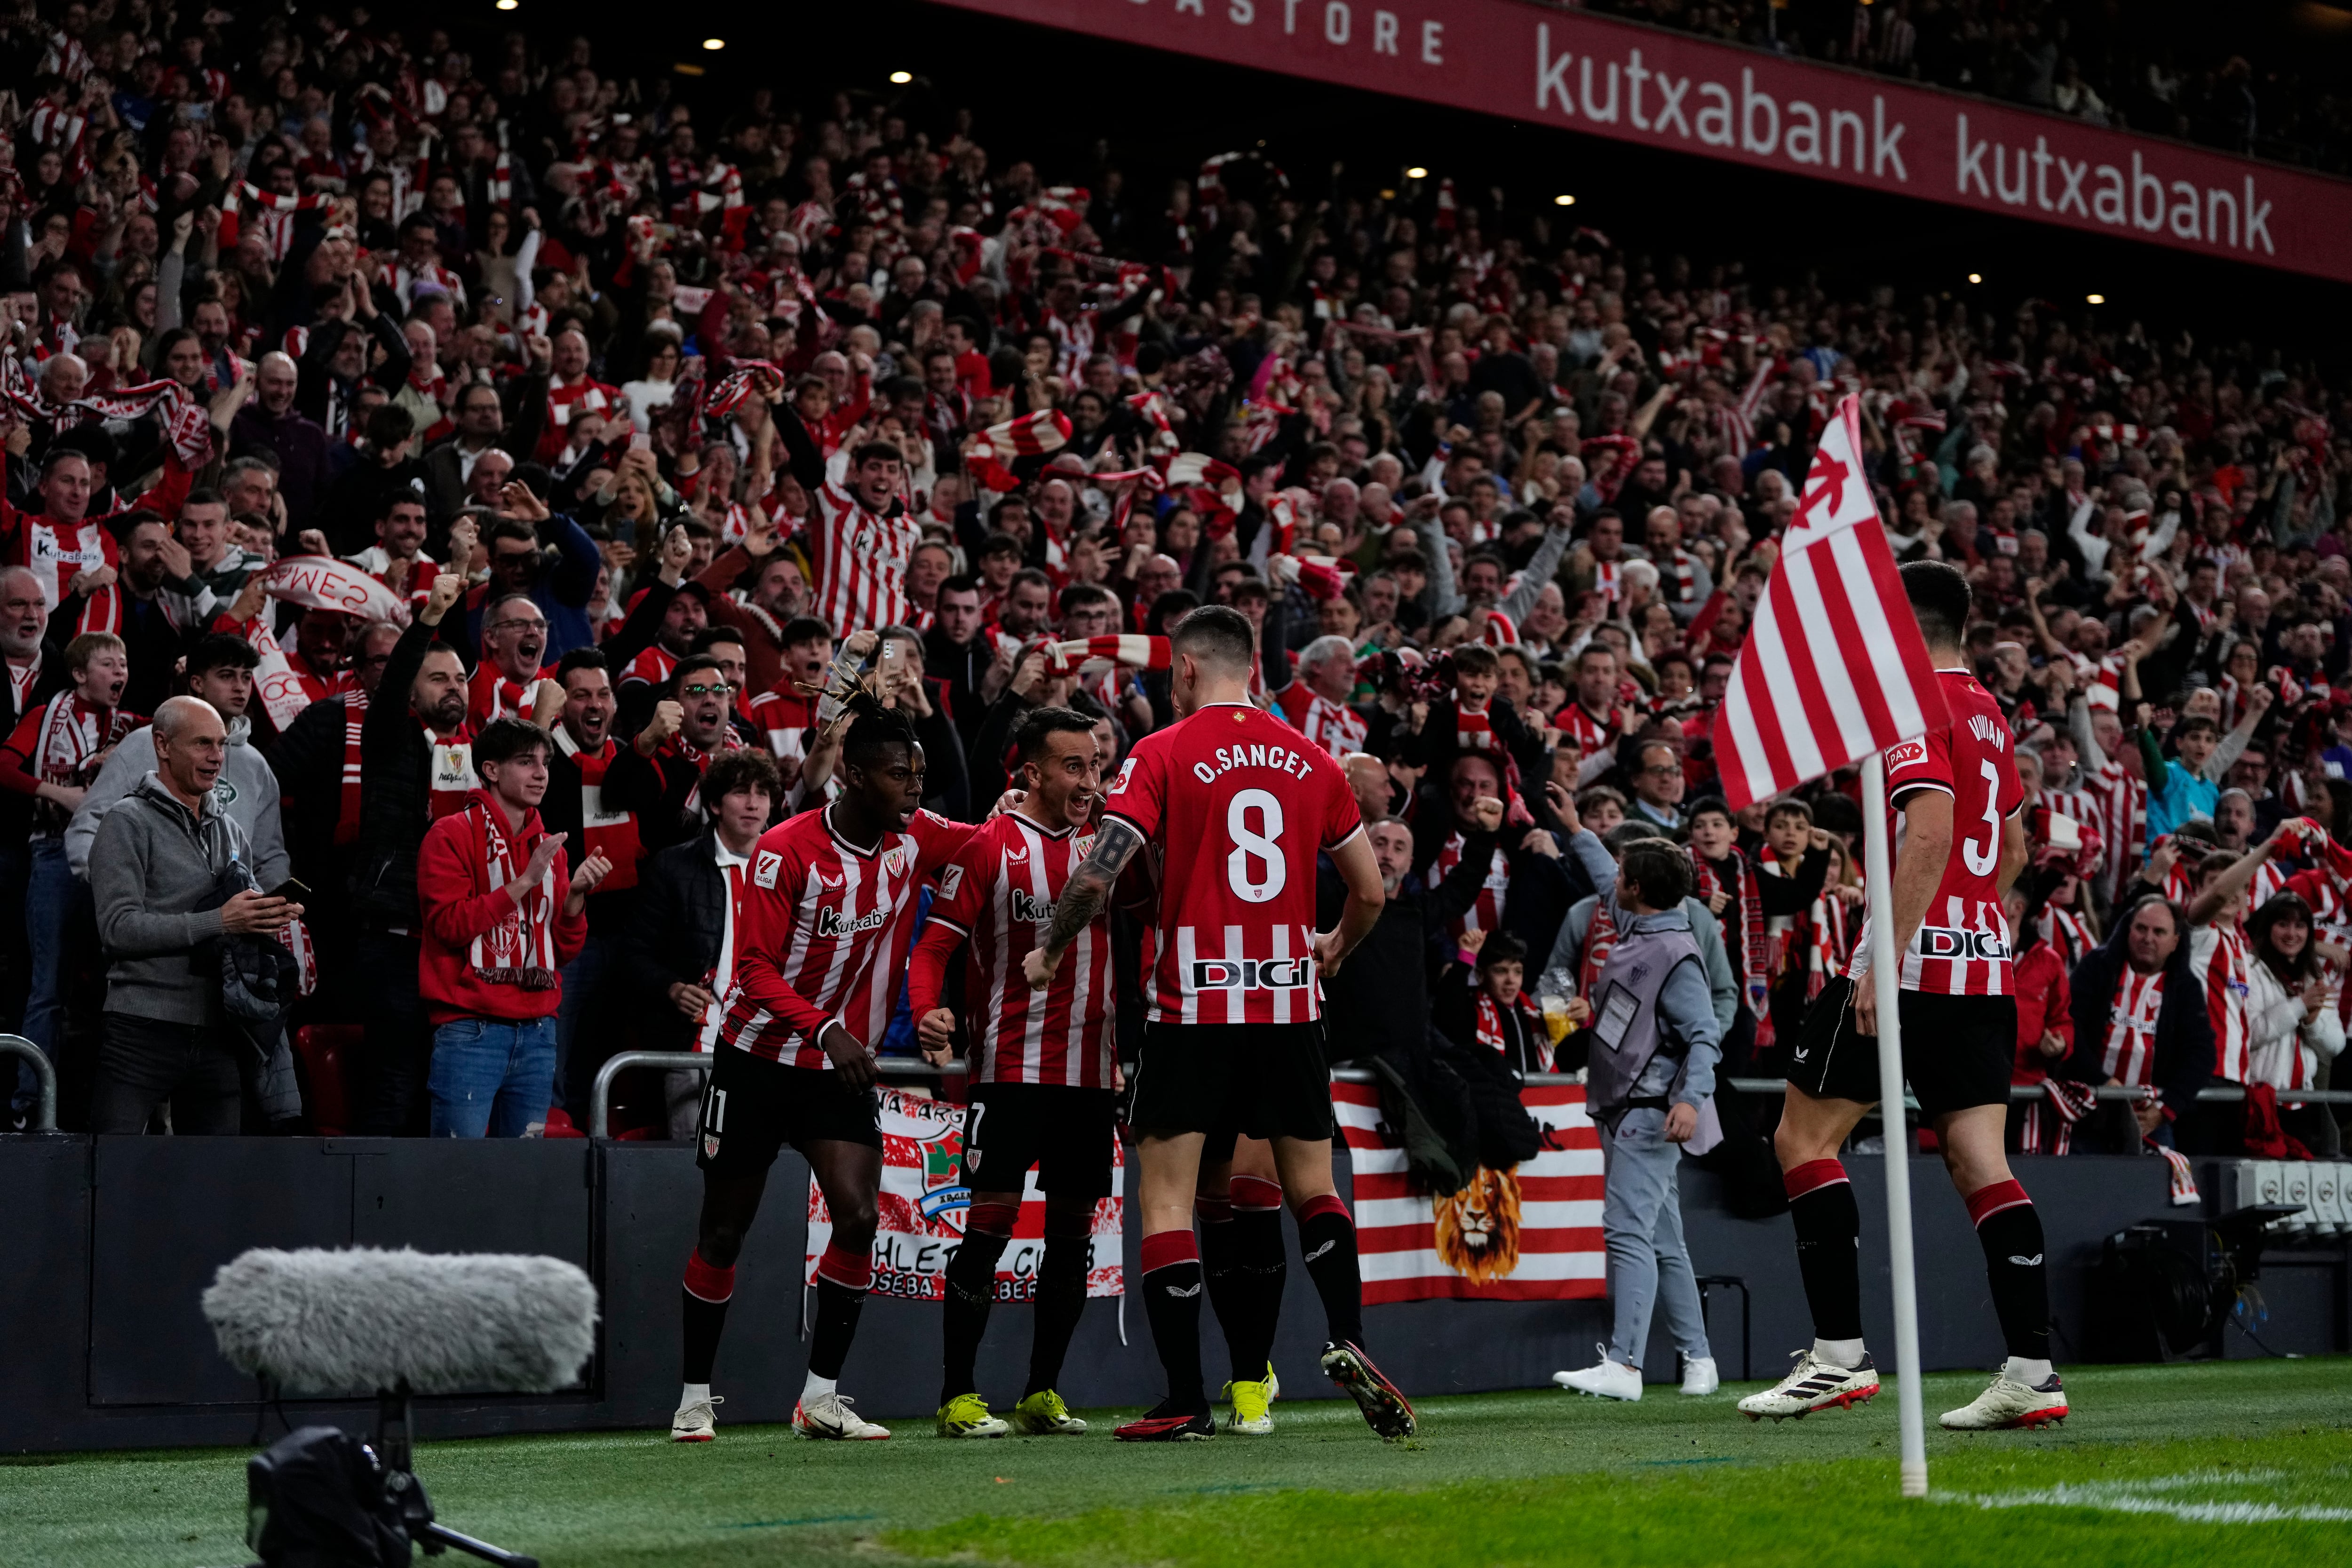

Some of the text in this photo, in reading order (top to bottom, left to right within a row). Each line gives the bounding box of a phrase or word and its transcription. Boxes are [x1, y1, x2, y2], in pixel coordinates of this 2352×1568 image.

[1136, 0, 1443, 64] STORE
[1536, 22, 1907, 181] kutxabank
[1957, 113, 2274, 254] kutxabank
[1890, 747, 1912, 765] PAY
[1967, 714, 2005, 753] VIVIAN
[1193, 744, 1313, 784] O.SANCET
[1963, 758, 2000, 876] 3
[1096, 824, 1135, 874] 8
[1227, 788, 1286, 903] 8
[1192, 960, 1309, 989] DIGI
[704, 1084, 727, 1133] 11
[970, 1102, 986, 1145] 7
